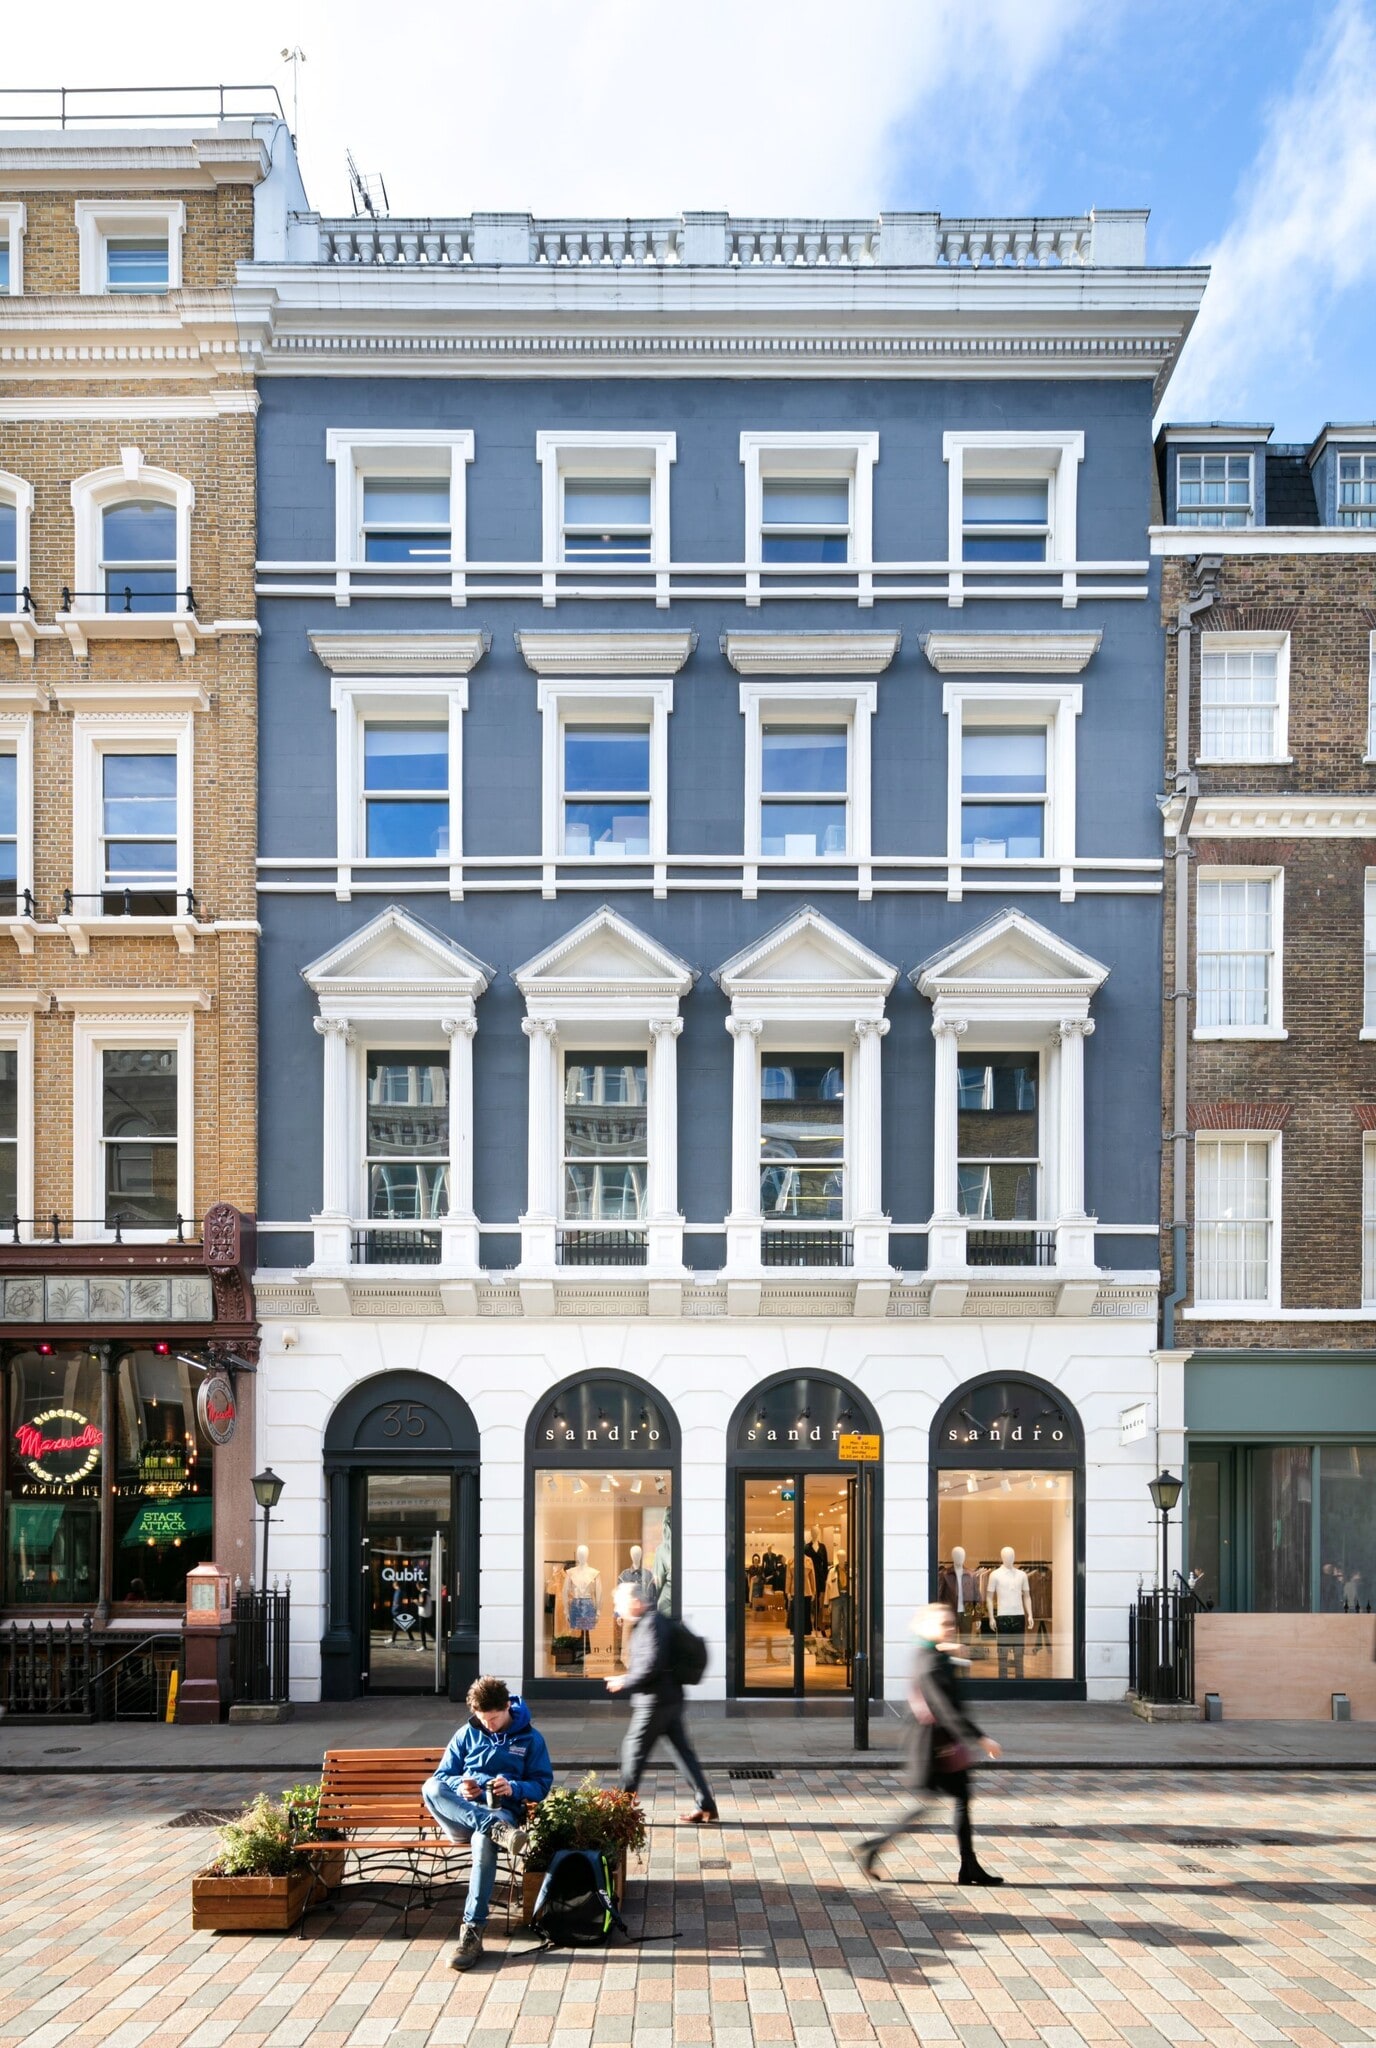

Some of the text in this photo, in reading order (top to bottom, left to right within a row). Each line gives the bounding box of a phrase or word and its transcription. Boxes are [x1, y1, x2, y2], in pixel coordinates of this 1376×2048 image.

[33, 1408, 88, 1425] BURGERS
[383, 1404, 425, 1437] 35
[545, 1425, 660, 1441] sandro
[949, 1426, 1064, 1441] sandro
[14, 1423, 104, 1461] Maxwell's
[143, 1512, 183, 1521] STACK
[139, 1521, 187, 1530] ATTACK
[381, 1567, 428, 1582] Qubit.
